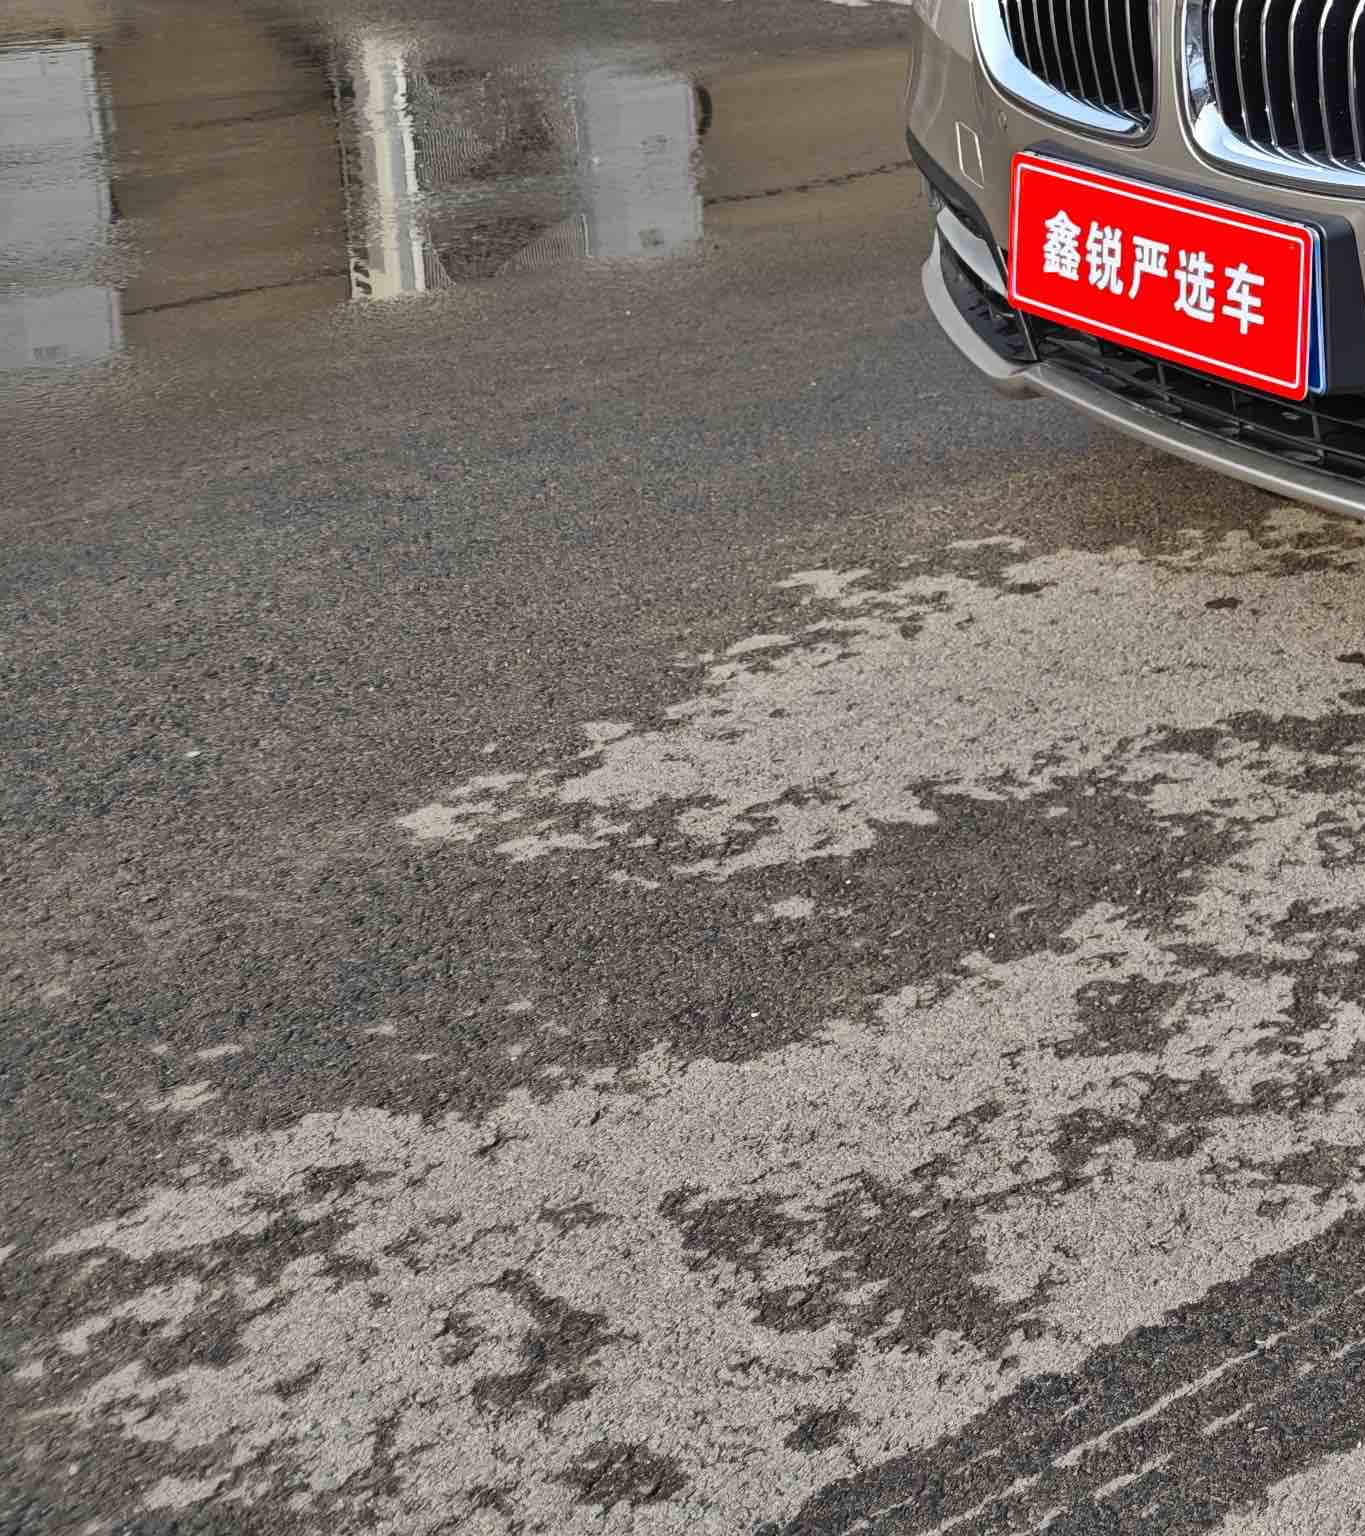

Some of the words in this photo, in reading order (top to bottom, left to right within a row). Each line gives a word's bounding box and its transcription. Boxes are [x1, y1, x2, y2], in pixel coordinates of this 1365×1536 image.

[1043, 209, 1265, 335] 鑫锐严选车
